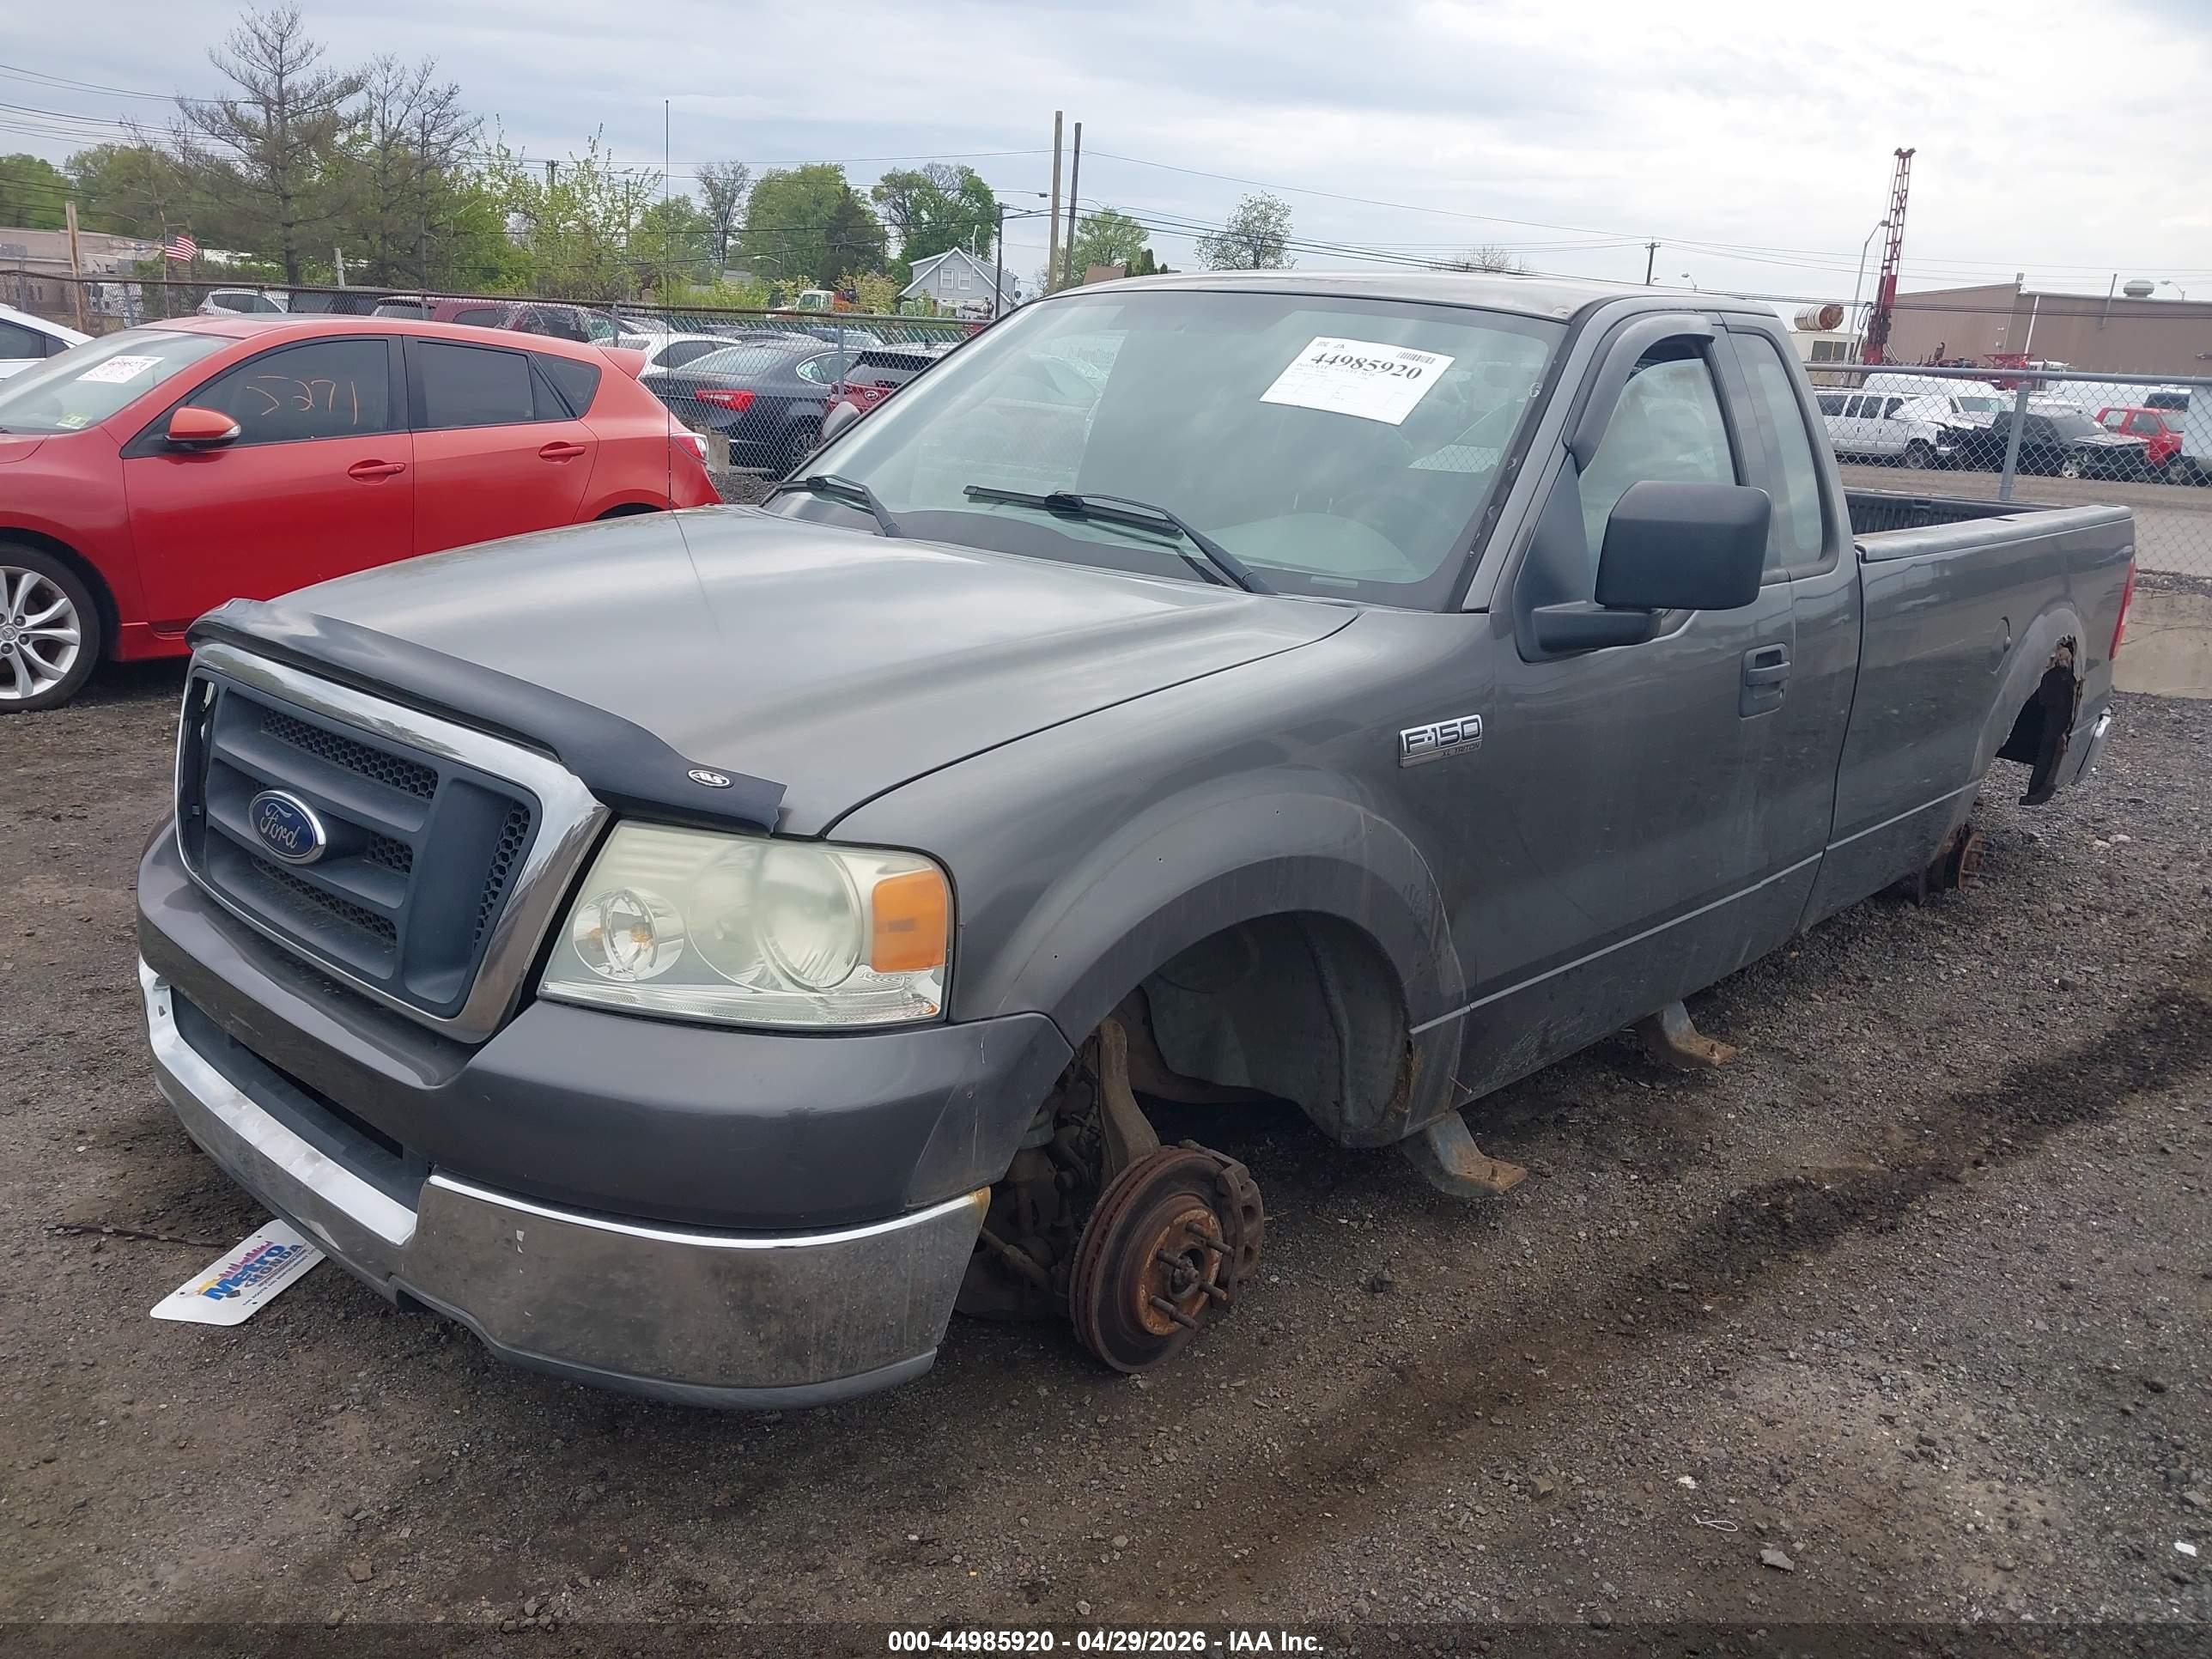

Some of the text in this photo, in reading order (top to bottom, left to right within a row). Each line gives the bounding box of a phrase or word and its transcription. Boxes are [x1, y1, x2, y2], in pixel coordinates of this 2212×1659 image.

[1310, 352, 1423, 380] 44985920
[260, 803, 301, 848] Ford
[247, 1244, 303, 1283] HONDA
